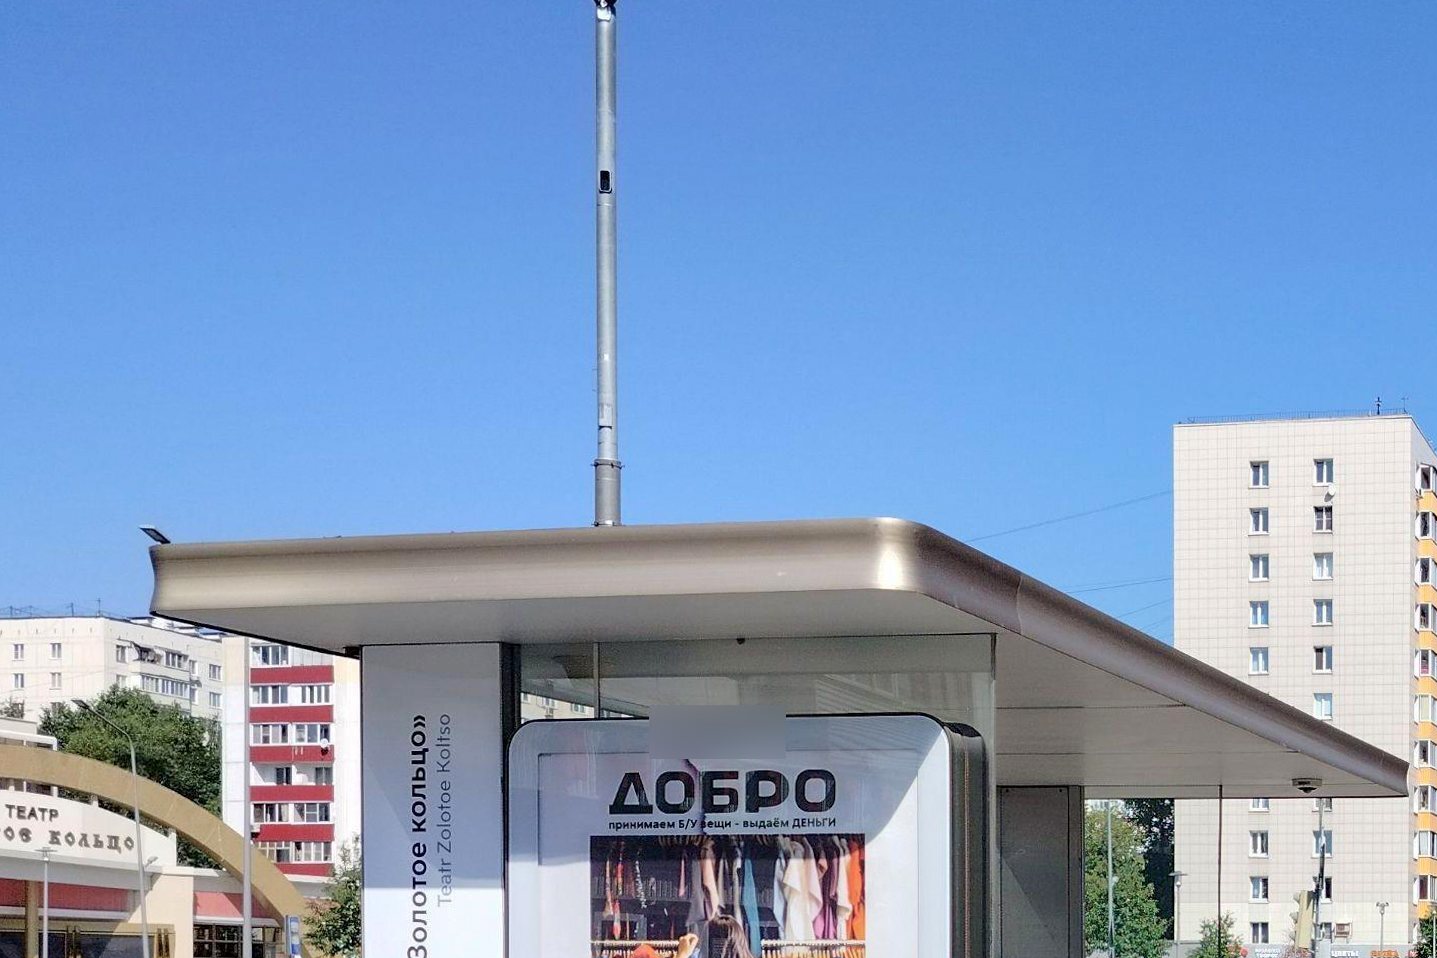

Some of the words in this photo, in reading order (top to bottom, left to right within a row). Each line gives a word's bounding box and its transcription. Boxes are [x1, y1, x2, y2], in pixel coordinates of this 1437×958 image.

[436, 713, 452, 773] Koltso
[411, 714, 429, 833] кольцо»
[609, 769, 836, 814] ДОБРО
[5, 804, 59, 822] ТЕАТР
[437, 781, 452, 853] Zolotoe
[609, 820, 675, 831] принимаем
[679, 819, 698, 830] Б/У
[700, 820, 731, 830] вещи
[743, 818, 789, 829] выдаём
[792, 817, 836, 829] ДЕНЬГИ
[48, 829, 135, 854] КОЛЬЦО
[437, 859, 452, 907] Teatr
